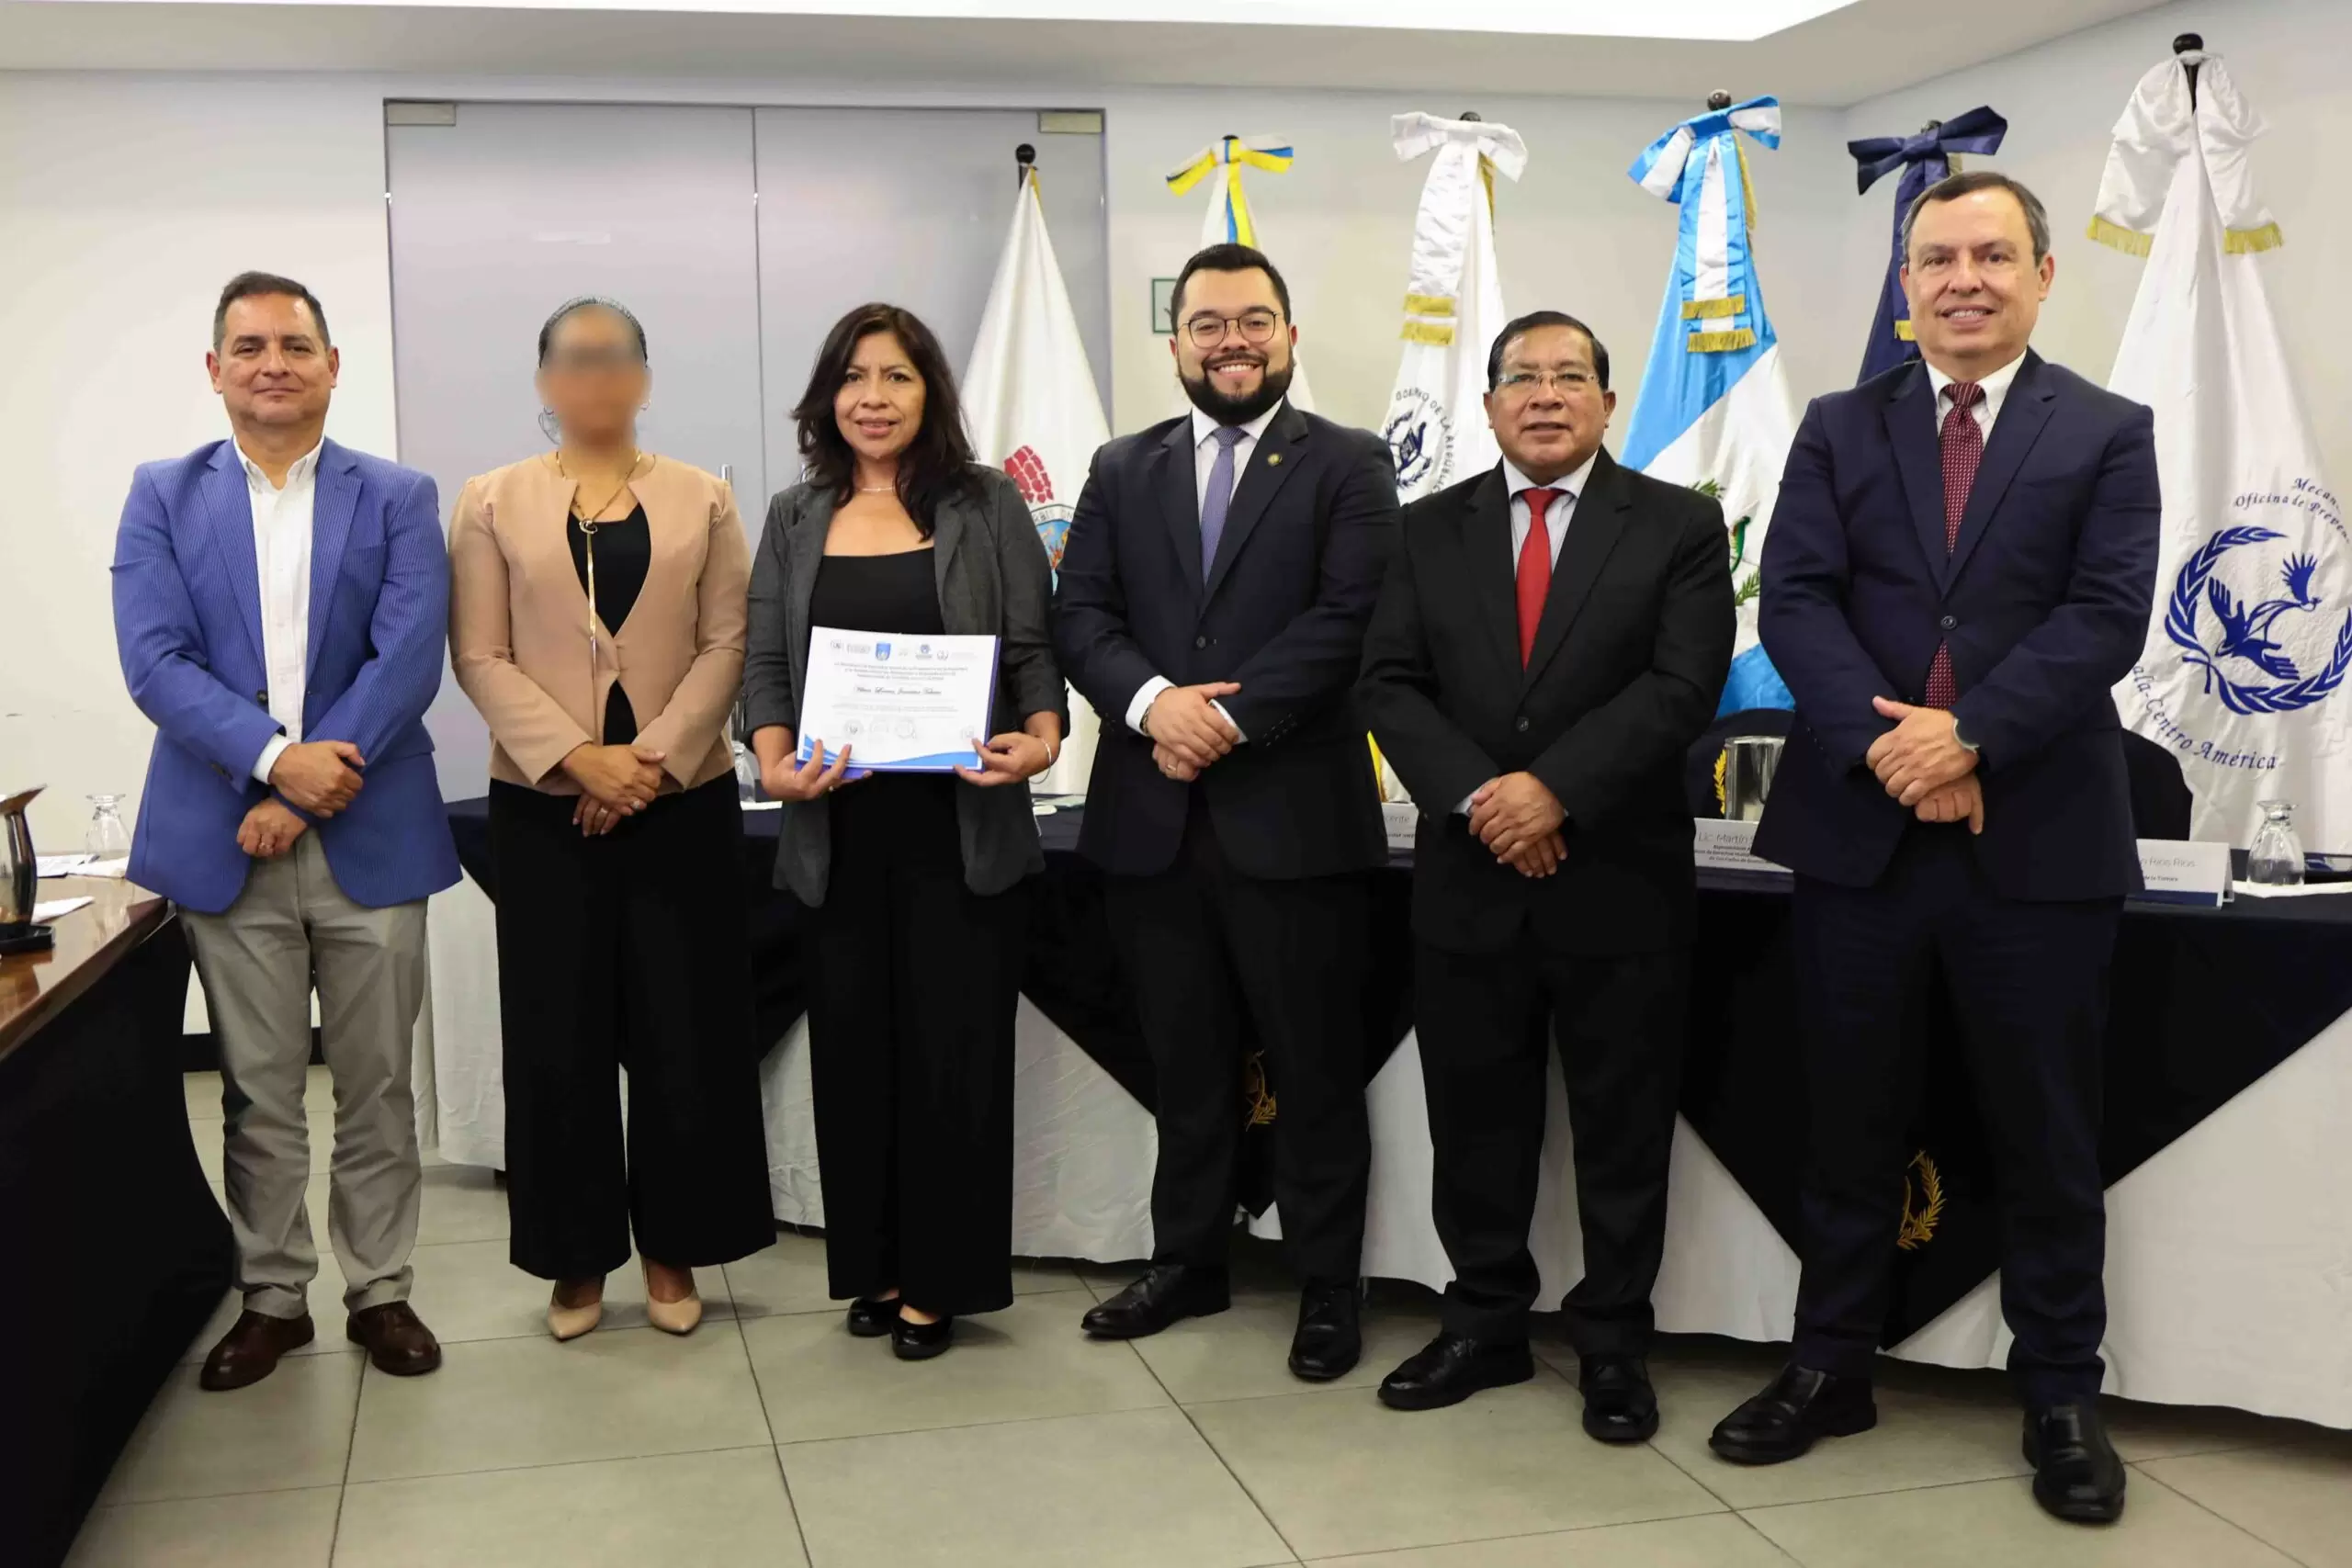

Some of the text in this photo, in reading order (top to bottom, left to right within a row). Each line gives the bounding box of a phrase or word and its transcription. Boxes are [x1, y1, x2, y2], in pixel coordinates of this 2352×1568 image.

[2233, 492, 2290, 510] Oficina
[2291, 494, 2305, 508] de
[2193, 741, 2277, 770] América
